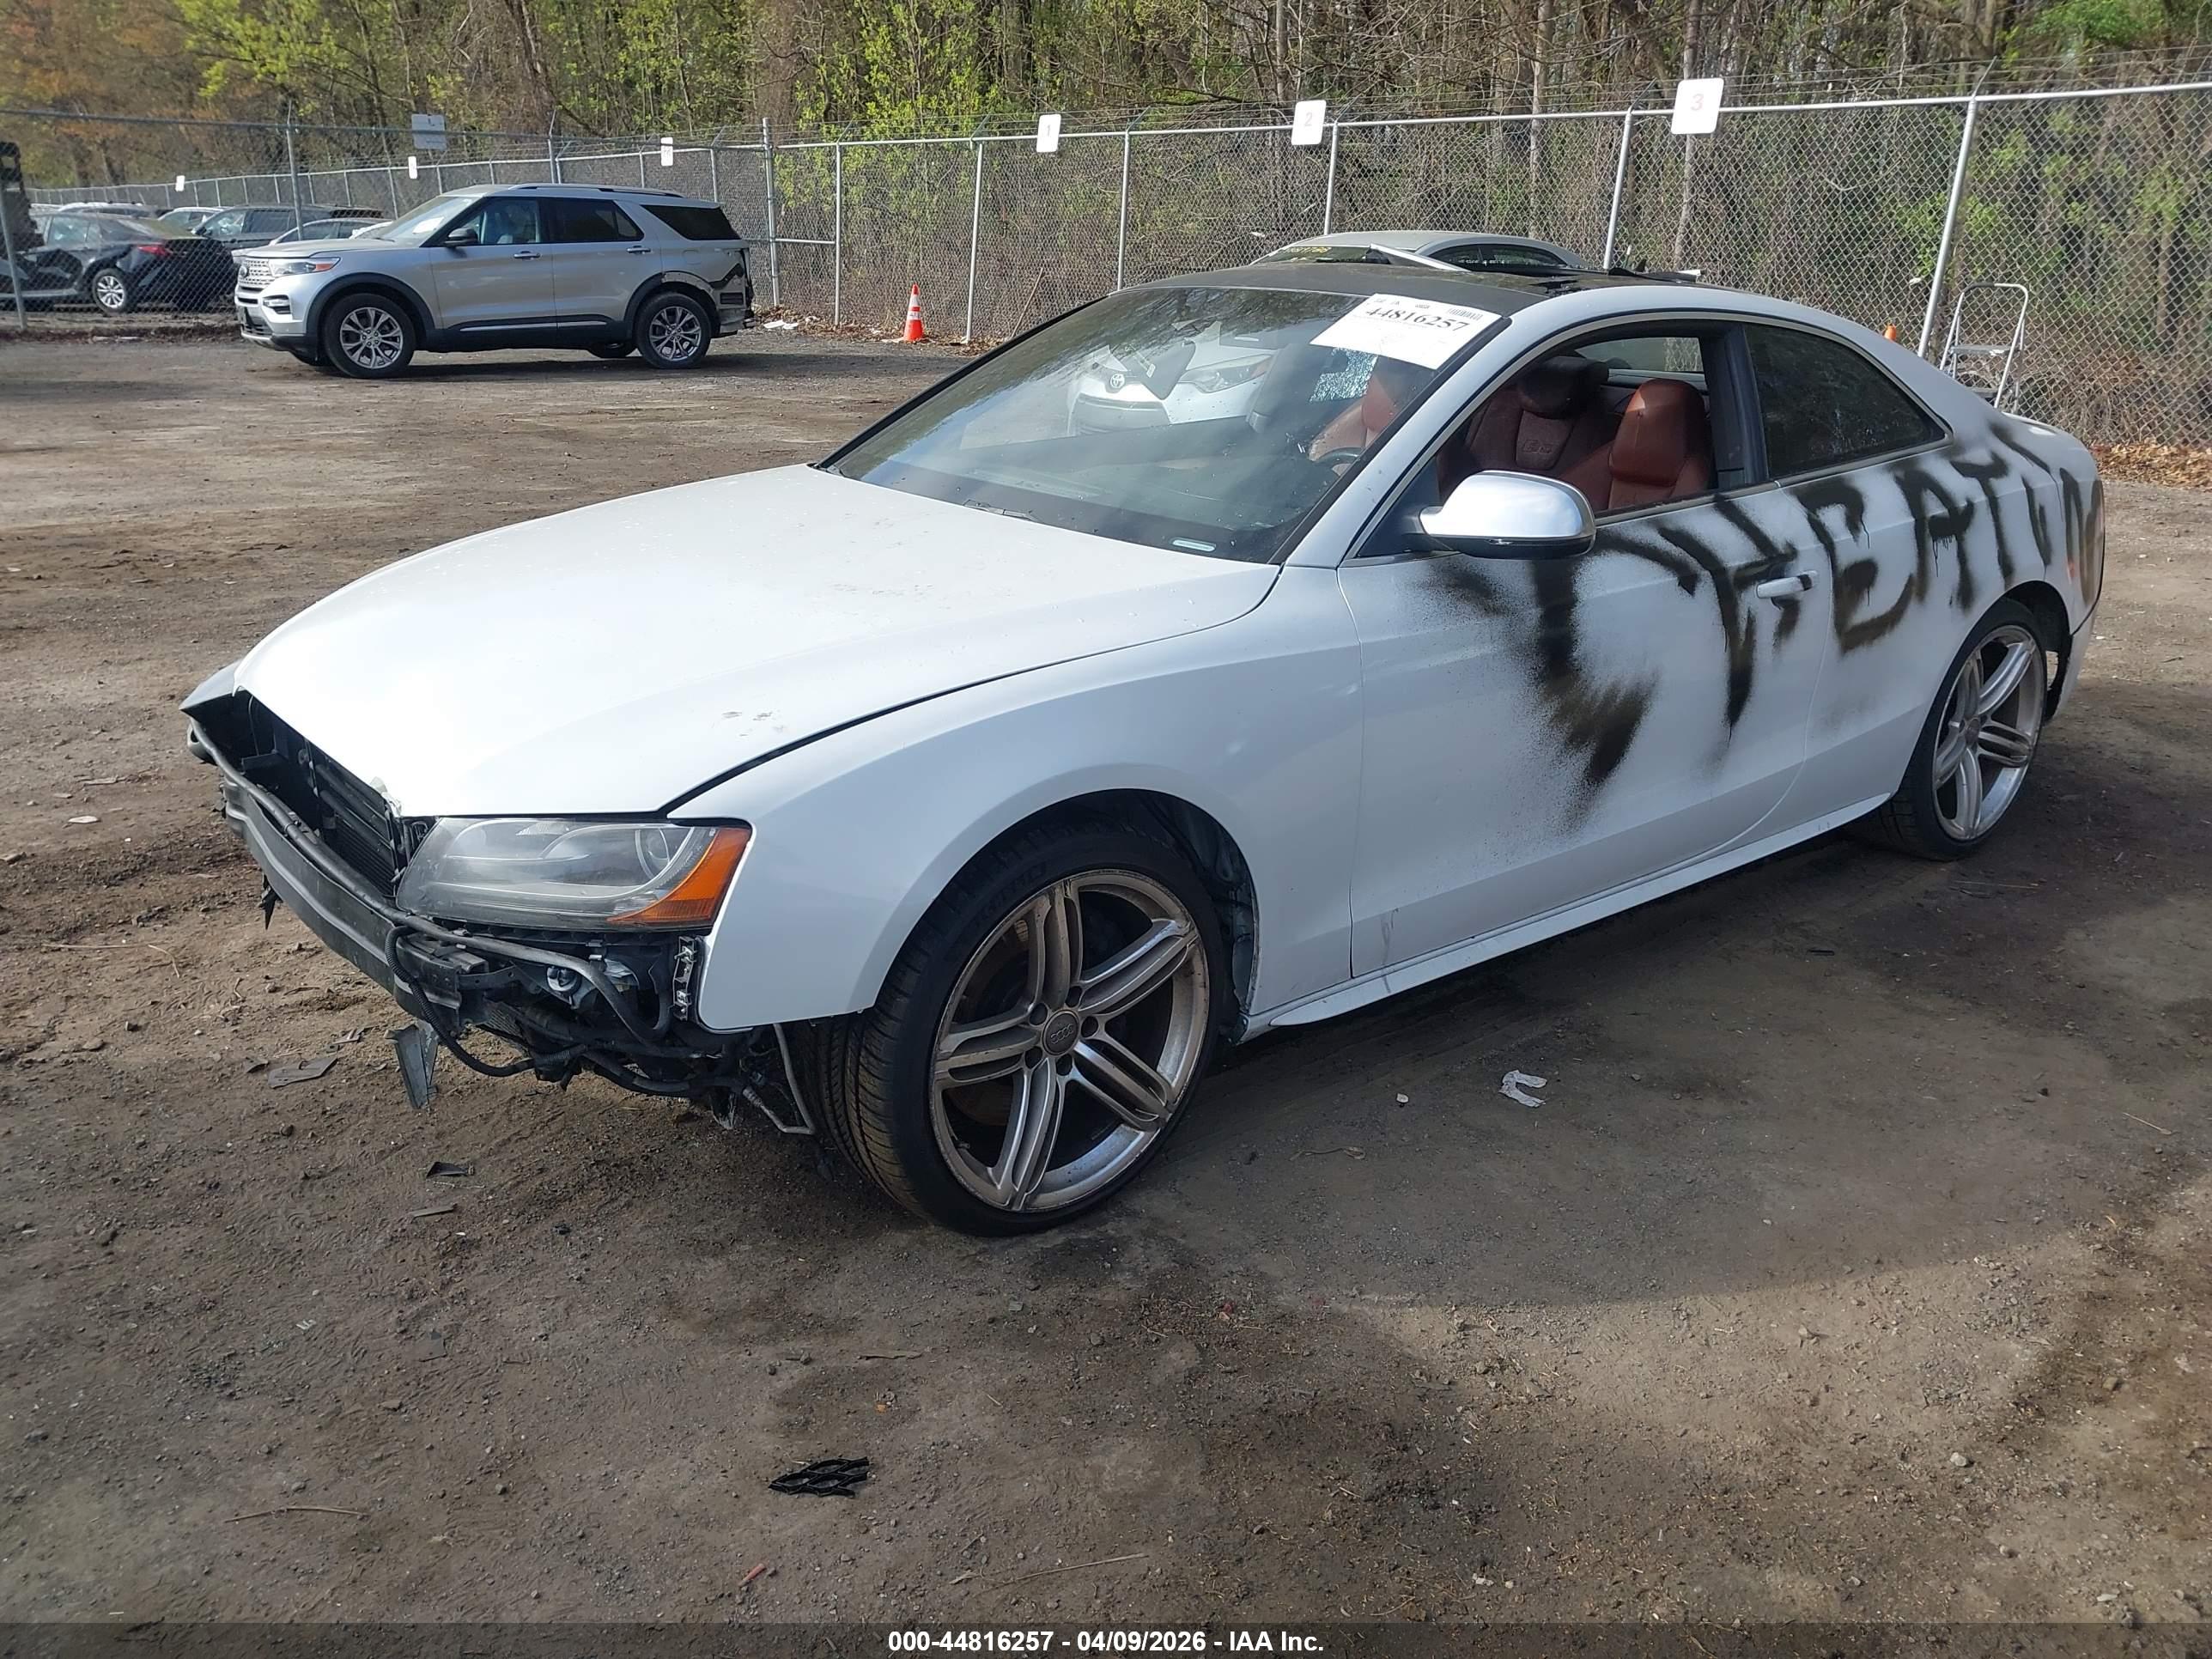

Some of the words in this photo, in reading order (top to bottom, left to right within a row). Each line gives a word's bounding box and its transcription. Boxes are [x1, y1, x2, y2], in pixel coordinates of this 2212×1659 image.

[1690, 93, 1705, 112] 3
[1304, 111, 1313, 127] 2
[1046, 124, 1052, 137] 1
[1365, 307, 1471, 331] 44816257
